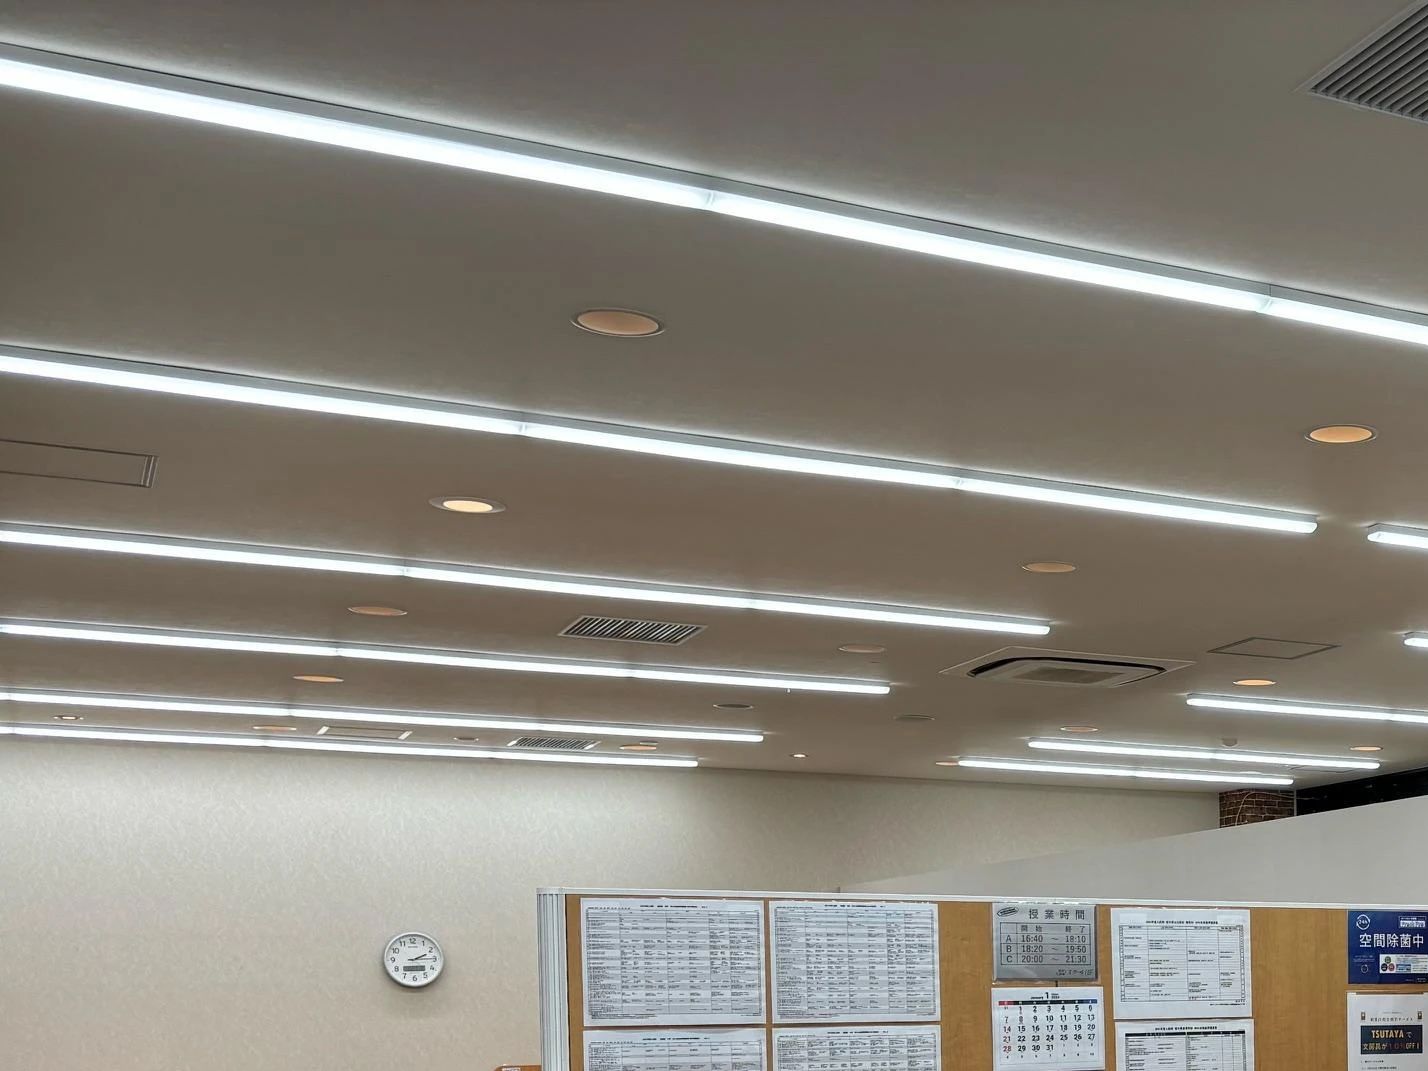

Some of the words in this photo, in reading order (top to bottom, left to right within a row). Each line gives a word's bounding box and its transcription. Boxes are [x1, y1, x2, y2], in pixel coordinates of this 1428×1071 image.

[1029, 908, 1085, 920] 授業時間
[1006, 934, 1012, 942] A
[1021, 934, 1043, 942] 16:40
[1360, 933, 1424, 948] 空間除菌中
[1021, 955, 1043, 963] 20:00
[1372, 1030, 1404, 1038] TSUTAYA
